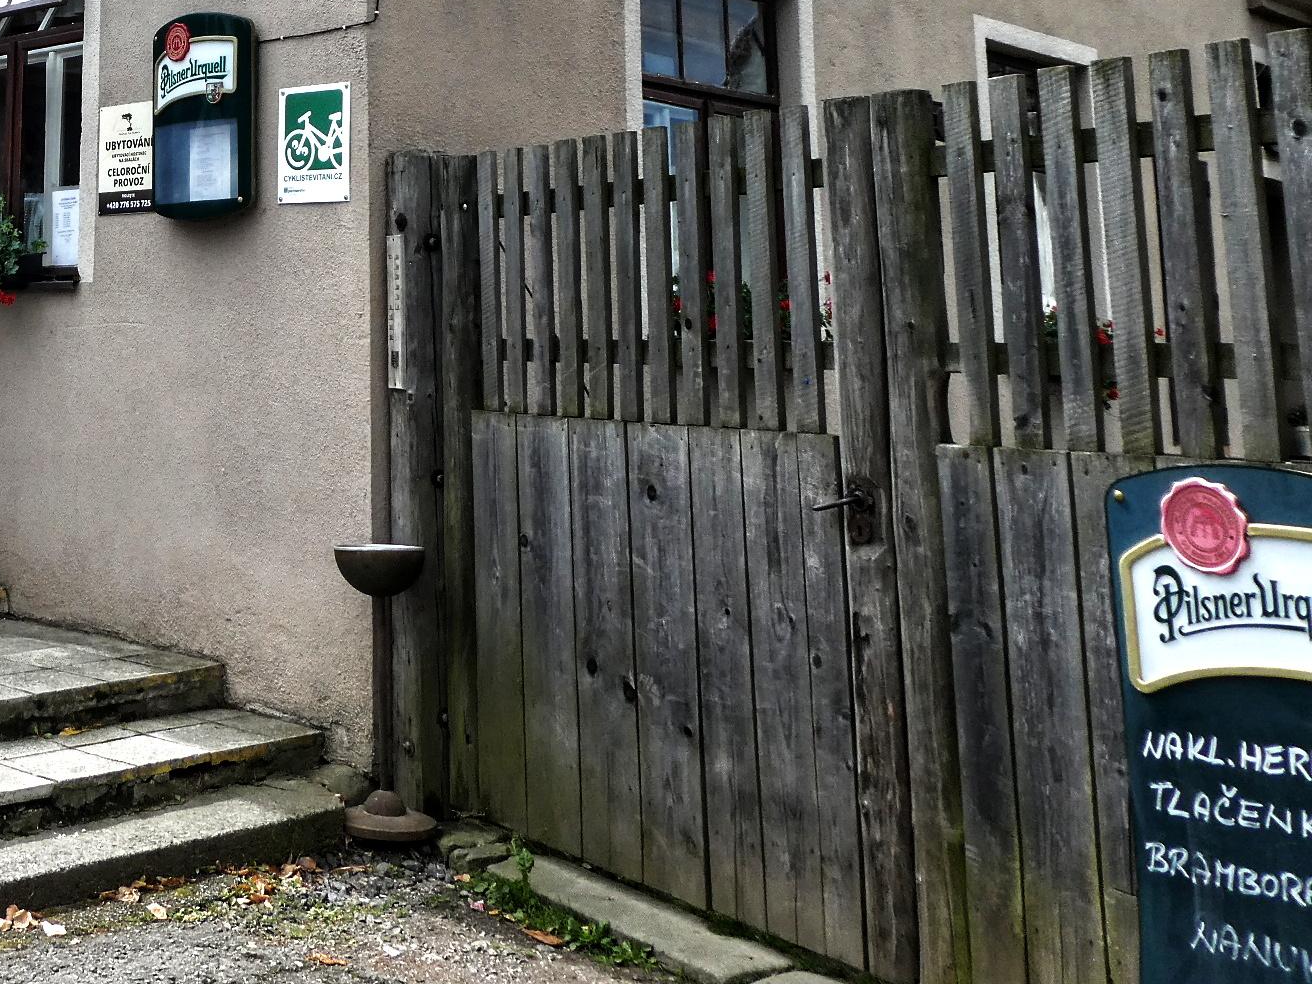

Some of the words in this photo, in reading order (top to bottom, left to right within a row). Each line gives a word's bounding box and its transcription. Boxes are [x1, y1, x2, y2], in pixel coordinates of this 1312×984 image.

[160, 64, 191, 99] Pilsner
[189, 56, 227, 83] Urquell
[108, 162, 150, 177] CELOROČNÍ
[283, 172, 343, 182] CYKLISTEVITANI.CZ
[114, 177, 144, 187] PROVOZ
[1152, 564, 1256, 643] Pilsner
